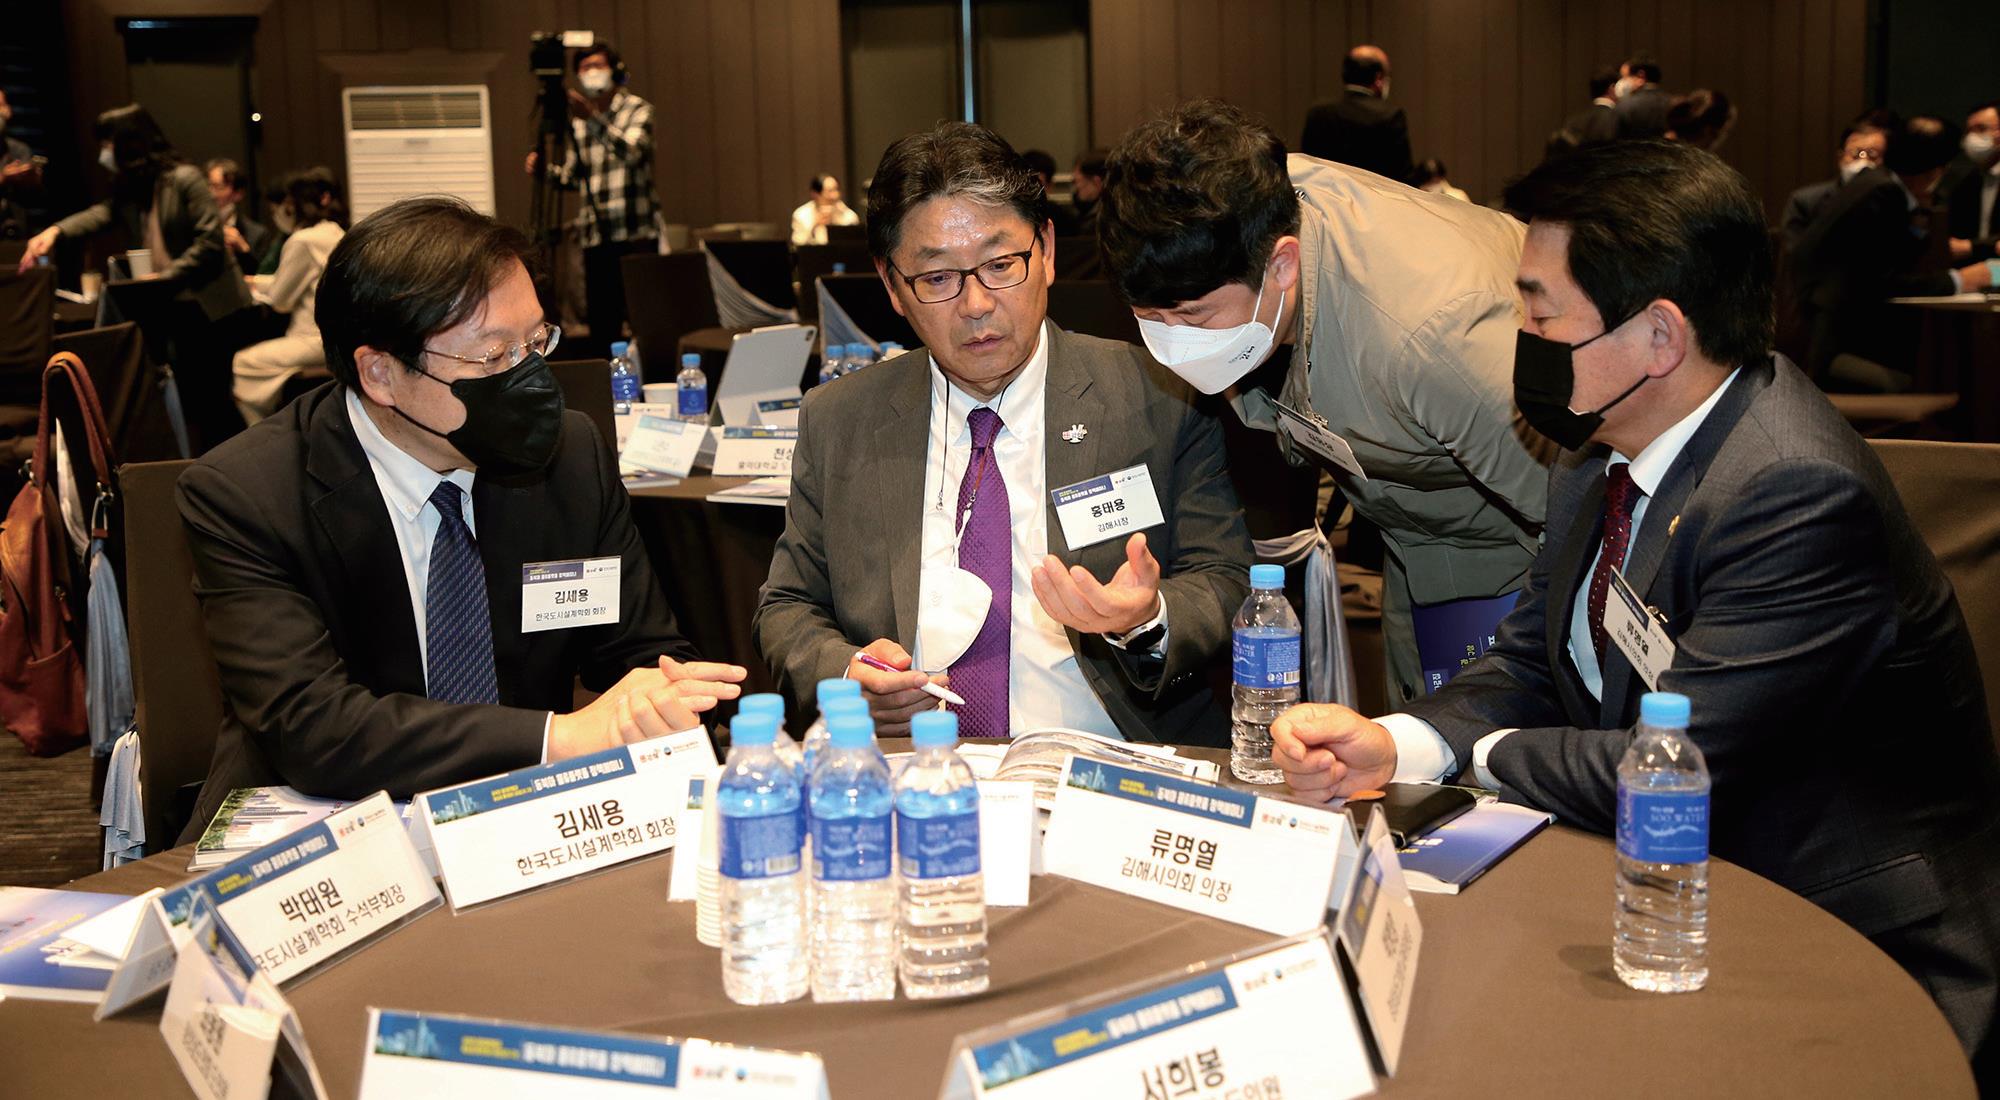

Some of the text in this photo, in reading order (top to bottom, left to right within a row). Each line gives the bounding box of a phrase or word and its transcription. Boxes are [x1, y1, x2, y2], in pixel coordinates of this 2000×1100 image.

[1091, 498, 1126, 518] 홍태용
[1098, 517, 1129, 533] 김해시장
[535, 606, 607, 622] 한국도시설계학회 회장
[554, 588, 589, 605] 김세용
[554, 799, 625, 839] 김세용
[516, 816, 677, 876] 한국도시설계학회 회장
[1150, 828, 1218, 870] 류명열
[279, 877, 343, 922] 박태원
[1121, 857, 1232, 903] 김해시의회 의장
[345, 884, 406, 927] 수석부회장
